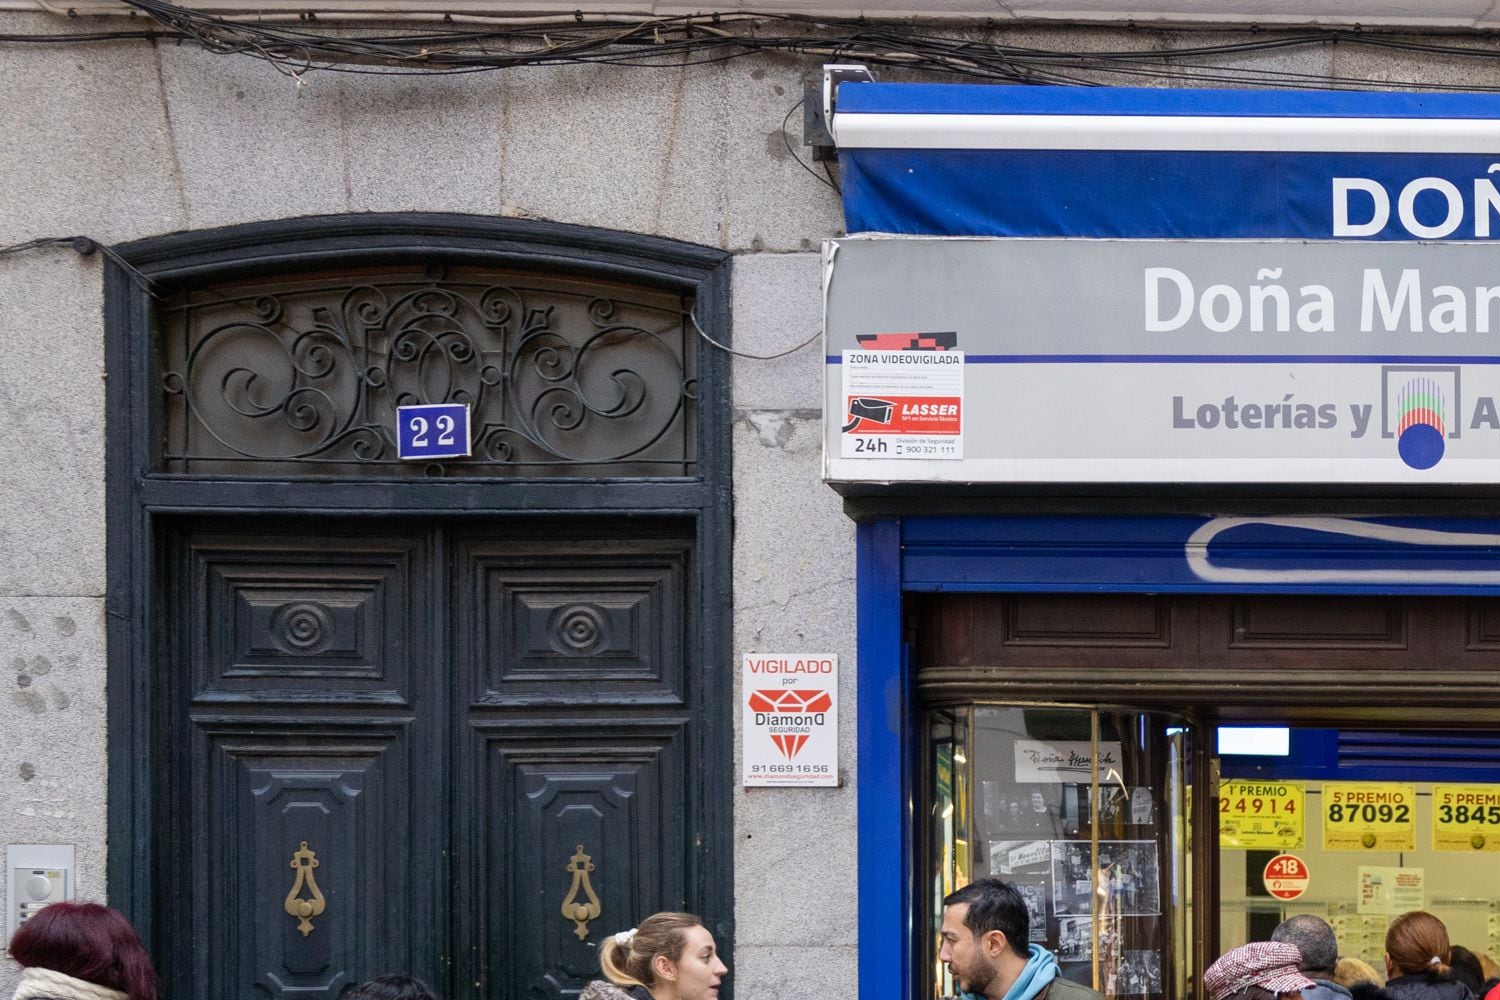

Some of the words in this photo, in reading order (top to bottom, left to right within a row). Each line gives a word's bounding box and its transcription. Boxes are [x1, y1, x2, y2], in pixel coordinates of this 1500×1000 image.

[1145, 267, 1335, 333] Doña
[850, 354, 878, 364] ZONA
[881, 355, 960, 365] VIDEOVIGILADA
[901, 404, 958, 416] LASSER
[1172, 393, 1338, 430] Loterías
[1349, 404, 1373, 439] y
[410, 414, 455, 448] 22
[855, 438, 887, 453] 24h
[749, 659, 833, 674] VIGILADO
[782, 678, 798, 686] por
[768, 726, 811, 734] SEGURIDAD
[752, 764, 766, 773] 91
[769, 764, 793, 773] 669
[796, 764, 811, 773] 16
[813, 764, 829, 773] 56
[1240, 785, 1287, 797] PREMIO
[1346, 792, 1404, 804] PREMIO
[1219, 797, 1296, 815] 24914
[1328, 803, 1410, 824] 87092
[1273, 859, 1299, 875] +18
